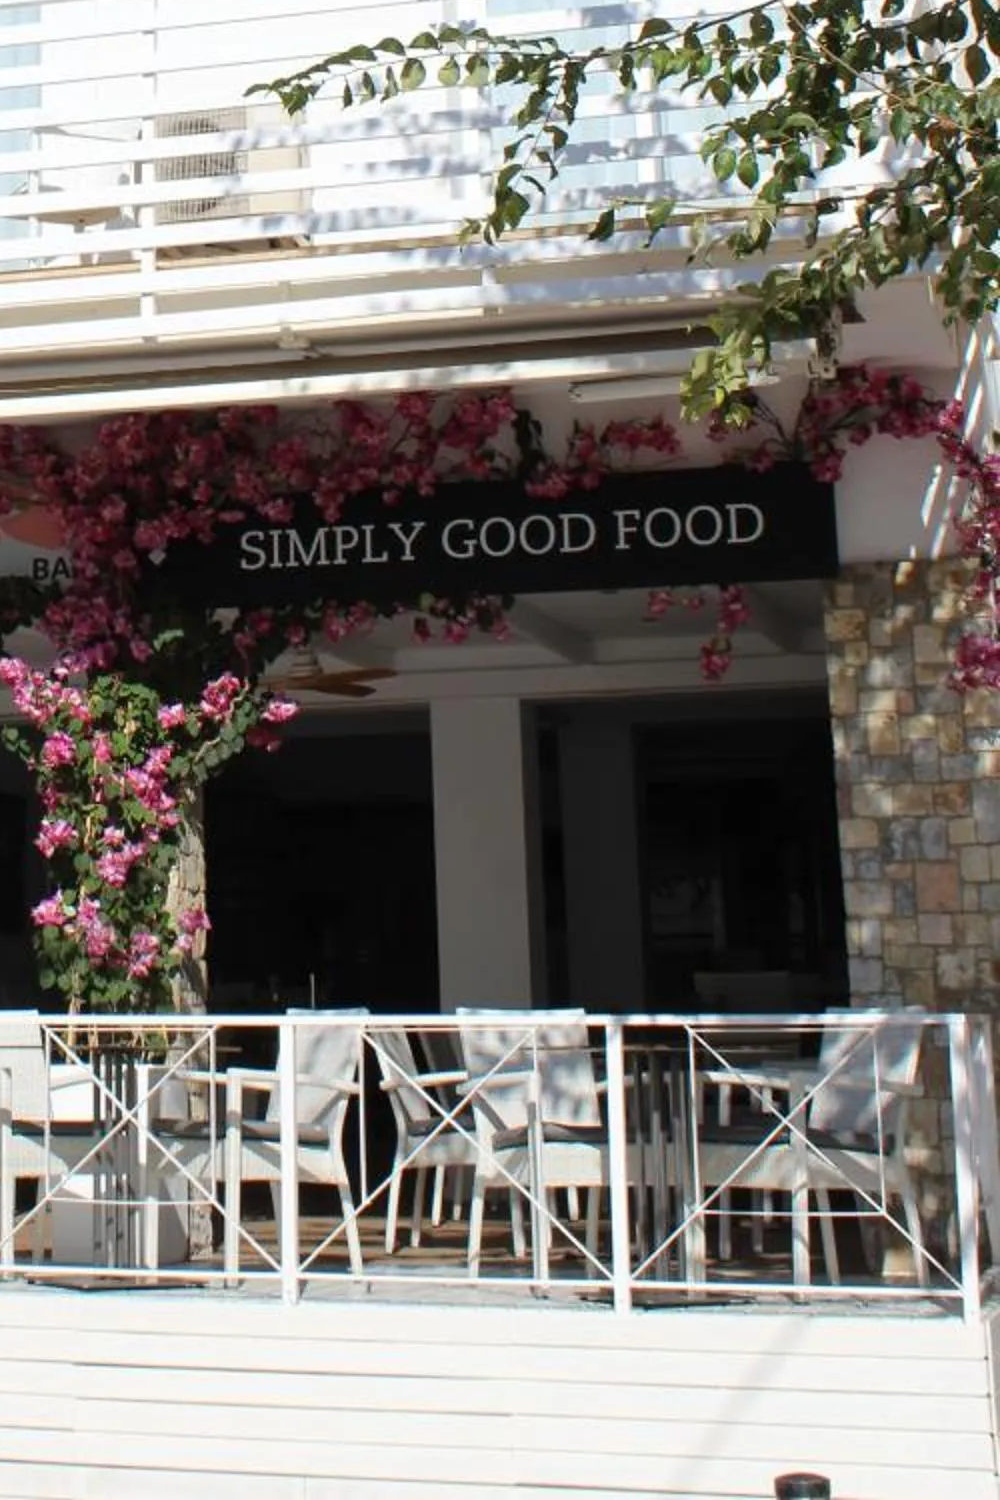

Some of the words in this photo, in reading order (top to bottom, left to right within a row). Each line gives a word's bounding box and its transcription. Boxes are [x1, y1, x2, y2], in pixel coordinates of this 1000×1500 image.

[240, 521, 426, 570] SIMPLY
[441, 514, 596, 559] GOOD
[613, 503, 764, 550] FOOD
